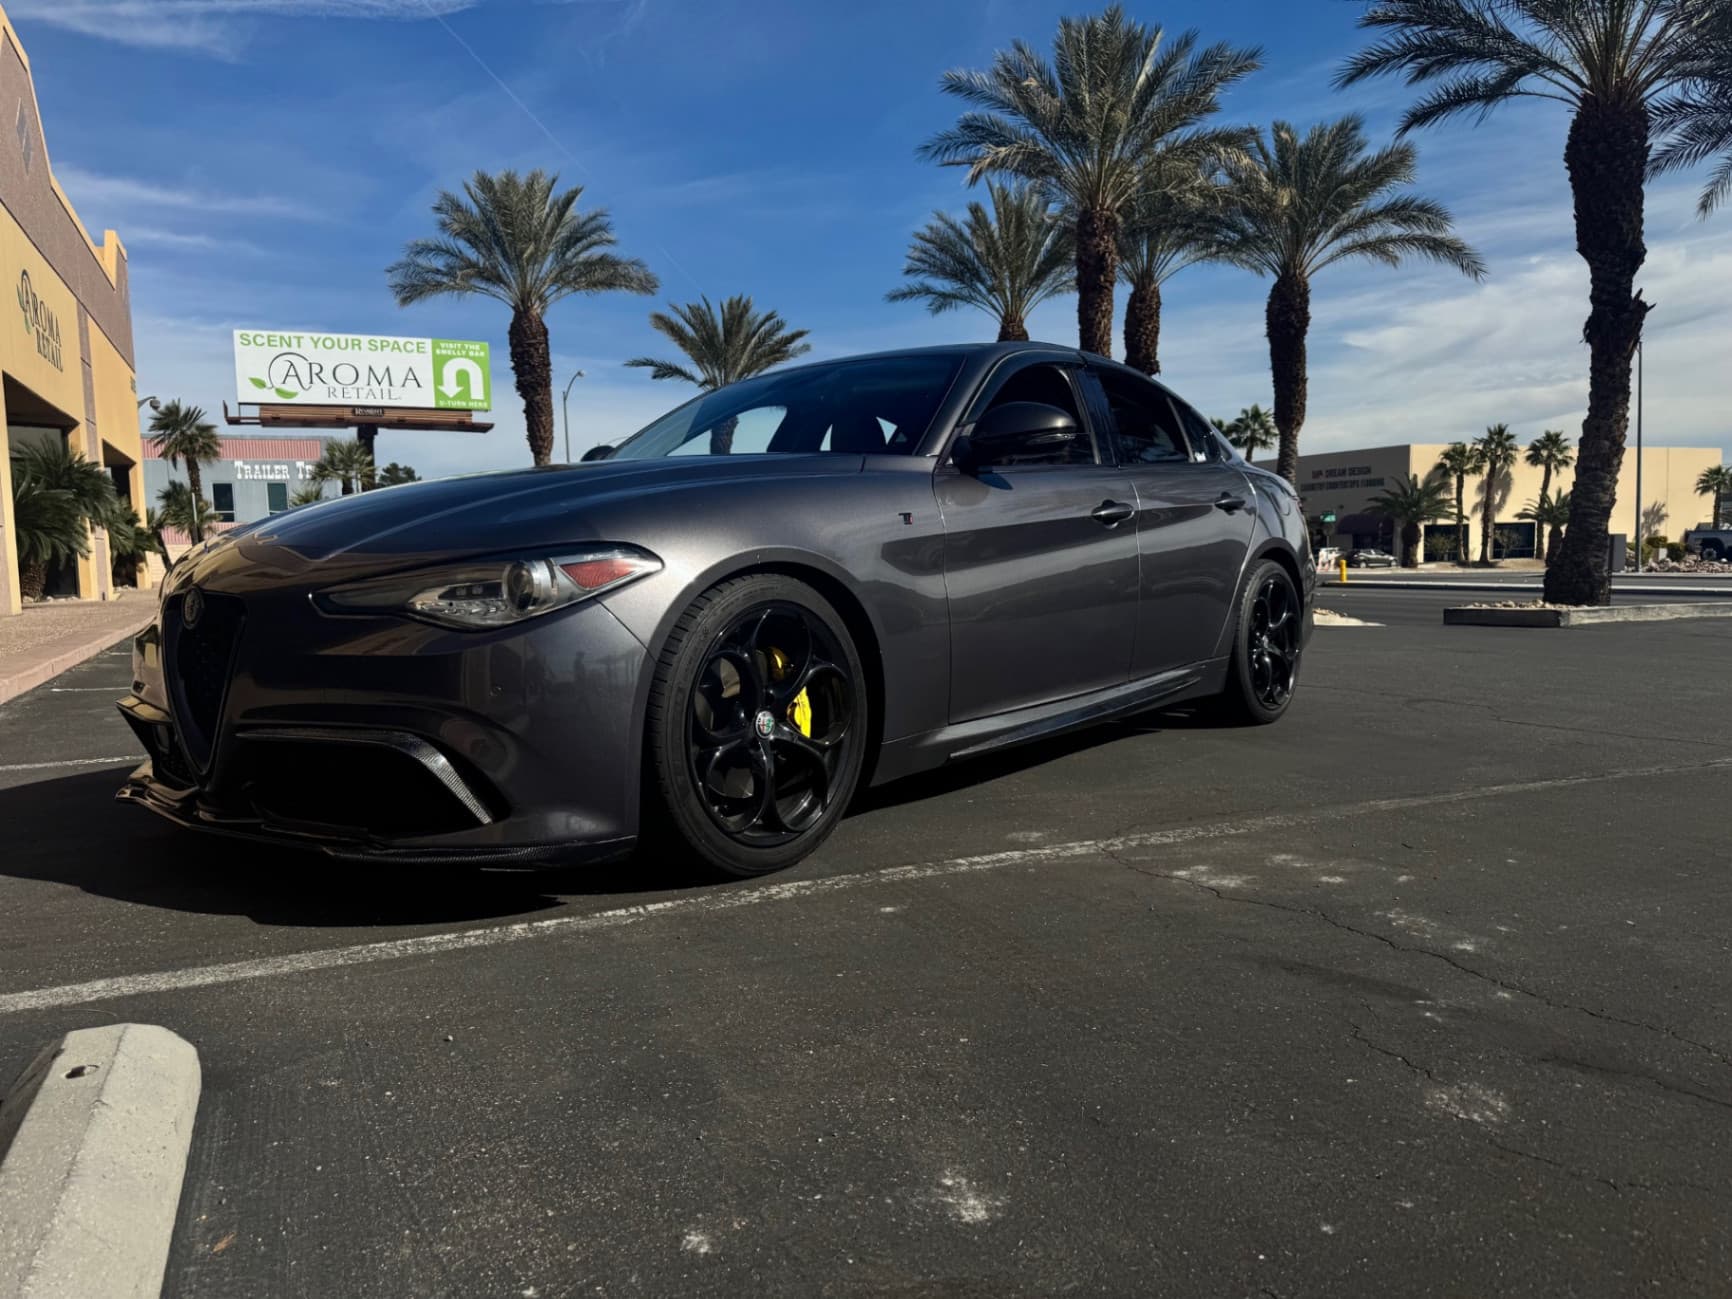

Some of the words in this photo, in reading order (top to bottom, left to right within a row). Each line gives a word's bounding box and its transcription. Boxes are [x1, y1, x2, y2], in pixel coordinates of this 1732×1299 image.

[20, 269, 61, 348] AROMA
[36, 327, 63, 373] RETAIL
[239, 332, 304, 349] SCENT
[309, 336, 362, 352] YOUR
[367, 338, 427, 354] SPACE
[266, 352, 422, 391] AROMA
[327, 386, 399, 400] RETAIL
[234, 460, 290, 480] TRAILER
